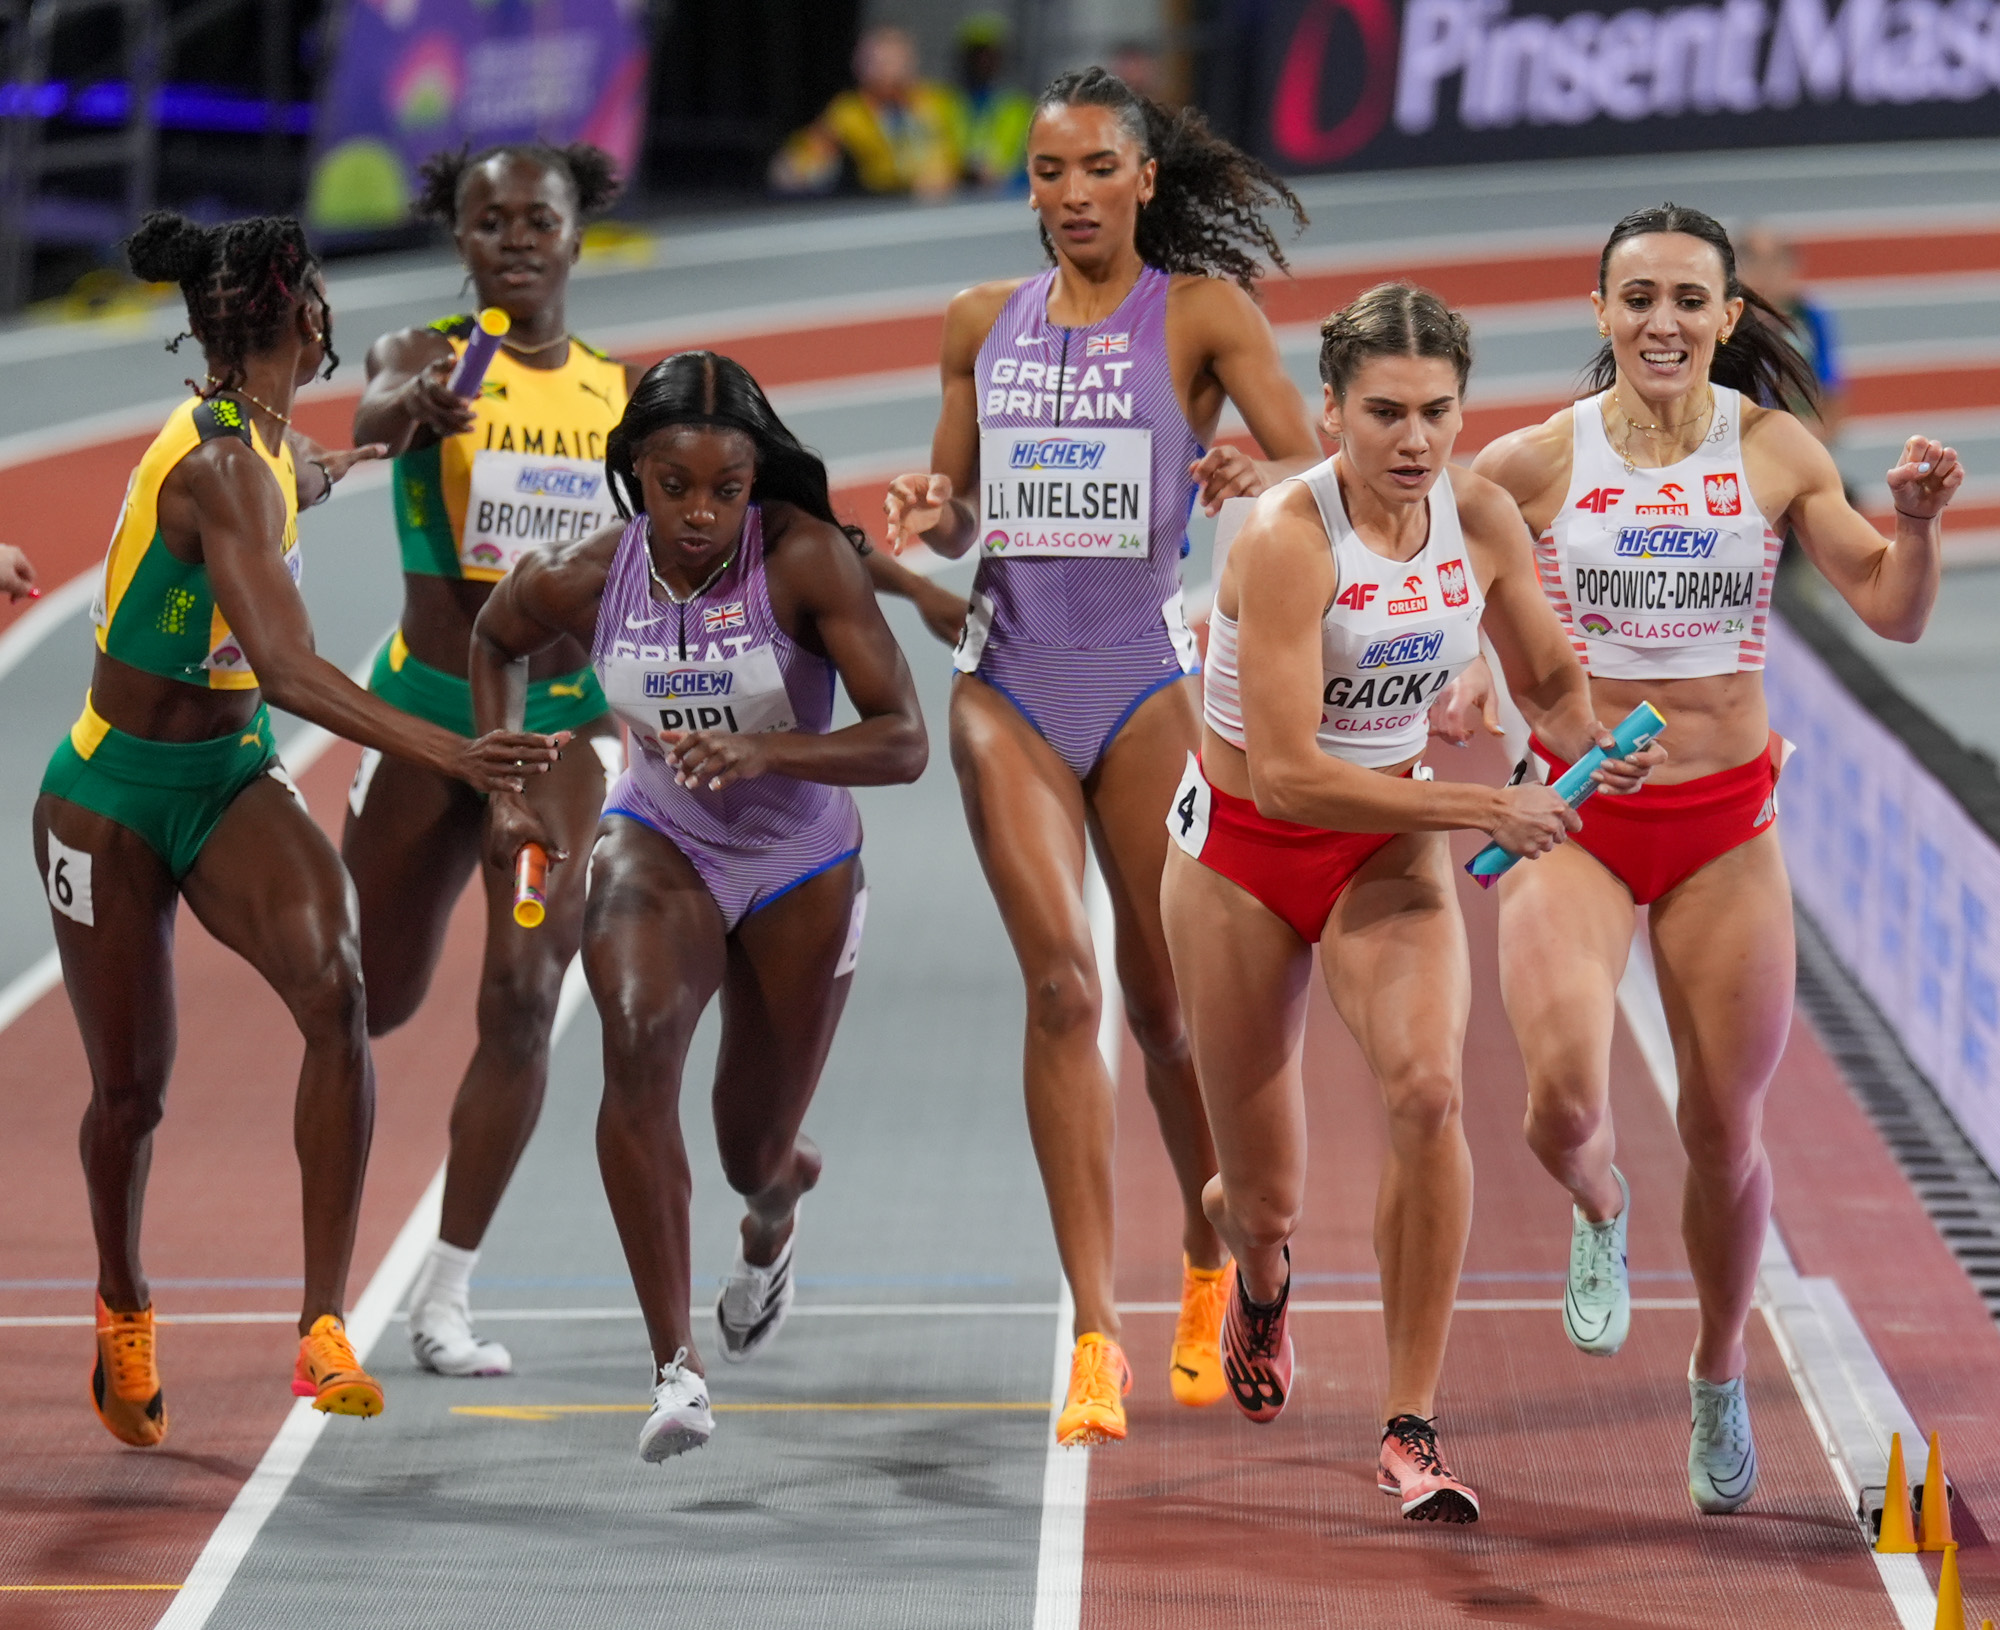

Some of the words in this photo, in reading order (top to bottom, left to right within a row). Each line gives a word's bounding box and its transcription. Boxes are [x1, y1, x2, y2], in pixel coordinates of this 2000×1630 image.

[1396, 0, 1762, 133] Pinsent
[991, 359, 1133, 391] GREAT
[985, 389, 1132, 421] BRITAIN
[487, 423, 604, 461] JAMAIC
[1009, 440, 1106, 470] HI-CHEW
[514, 466, 602, 500] HI-CHEW
[987, 483, 1009, 520] Li.
[1017, 482, 1139, 520] NIELSEN
[1575, 488, 1625, 513] 4F
[1014, 532, 1113, 548] GLASGOW
[1118, 534, 1141, 549] 24
[1614, 527, 1719, 559] HI-CHEW
[1336, 583, 1379, 610] 4F
[1576, 568, 1754, 609] POPOWICZ-DRAPAŁA
[1389, 599, 1426, 614] ORLEN
[1620, 620, 1721, 639] GLASGOW
[1357, 630, 1444, 669] HI-CHEW
[643, 670, 733, 697] HI-CHEW
[1323, 670, 1449, 709] GACKA
[659, 705, 739, 734] PIPI
[1177, 786, 1197, 837] 4
[55, 857, 73, 907] 6
